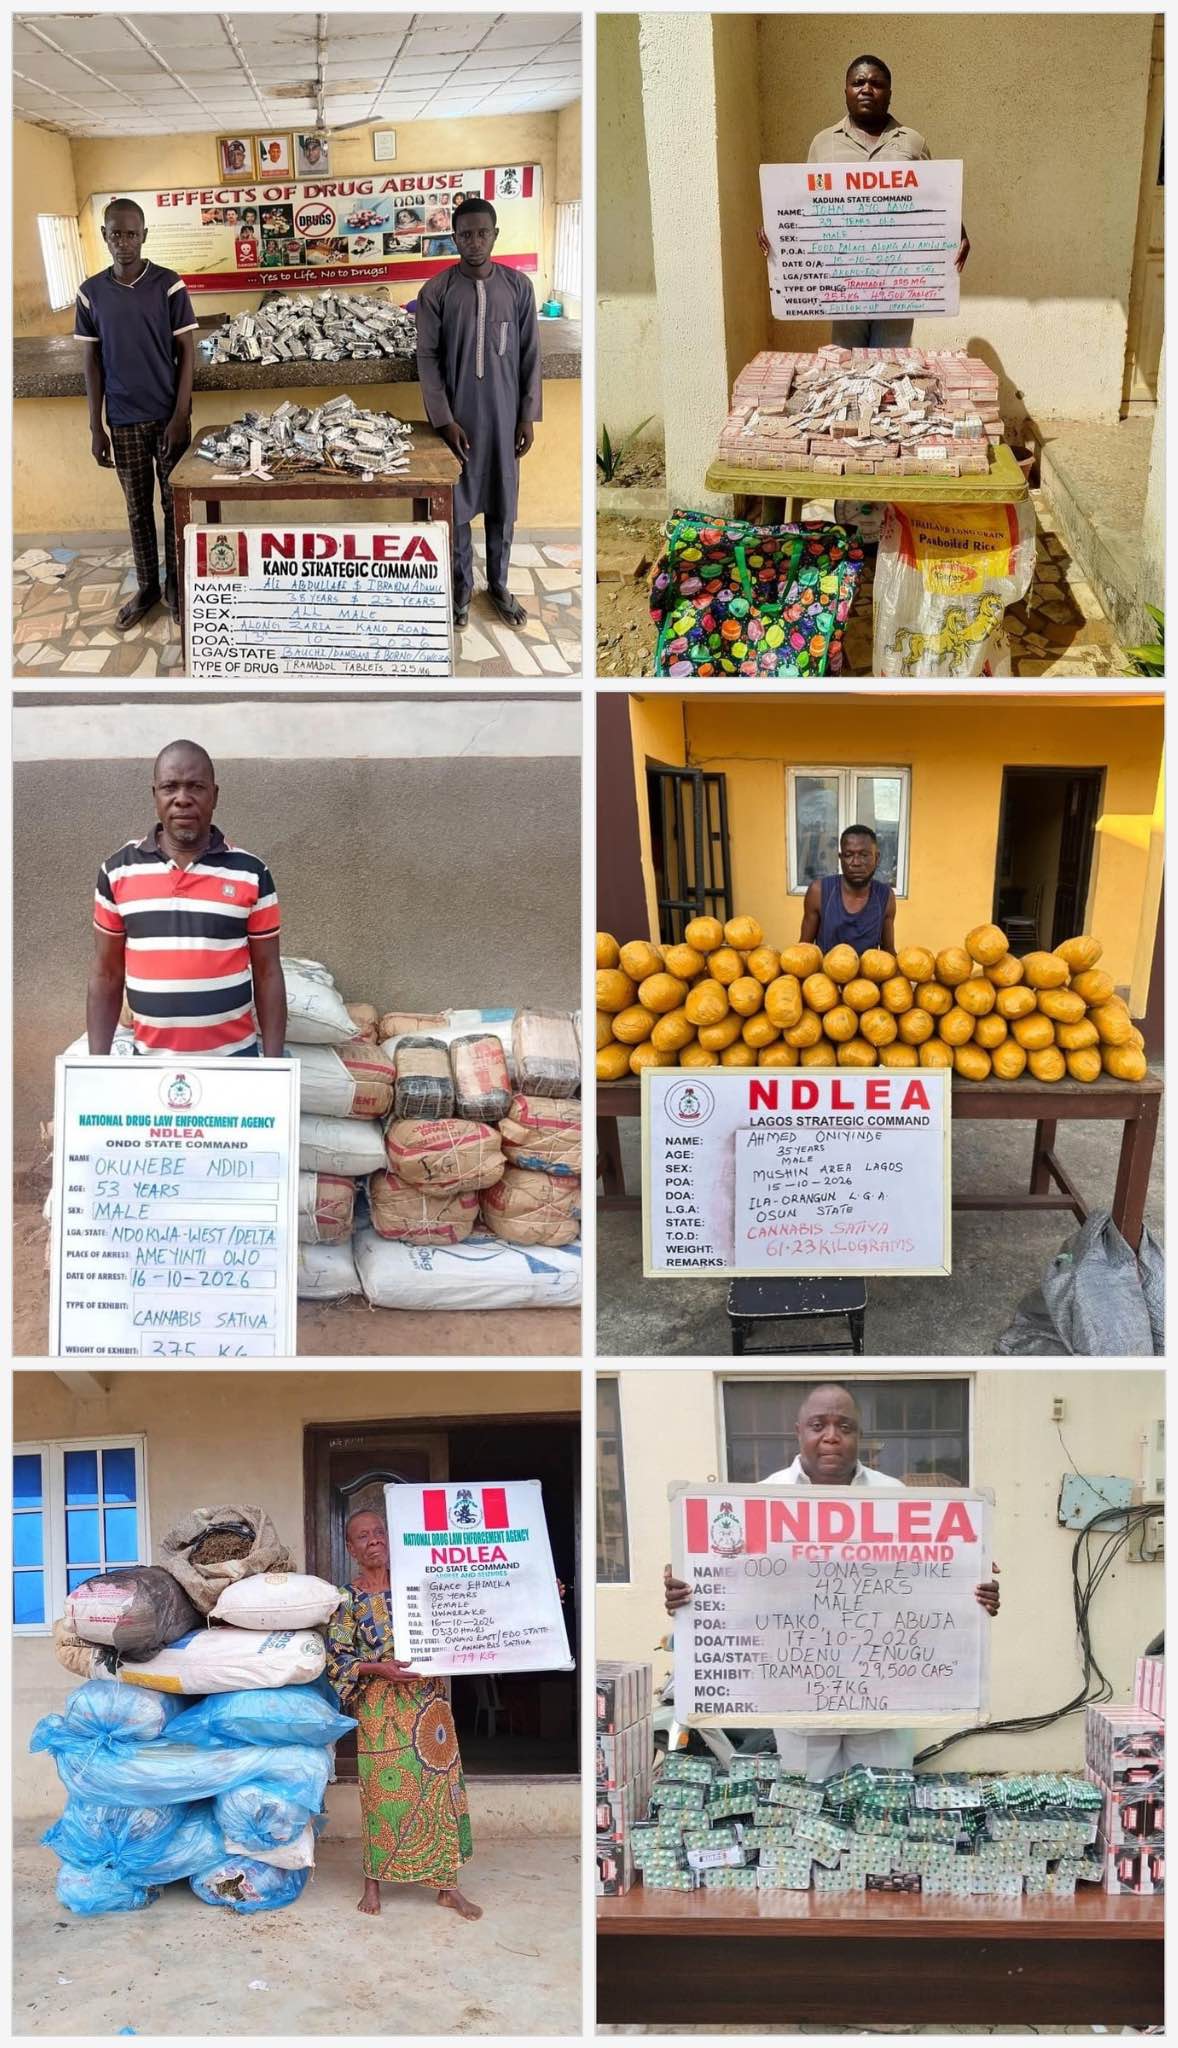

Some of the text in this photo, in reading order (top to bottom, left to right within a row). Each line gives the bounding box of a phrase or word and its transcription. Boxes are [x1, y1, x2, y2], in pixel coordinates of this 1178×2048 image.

[846, 170, 919, 190] NDLEA
[157, 173, 464, 208] EFFECTS OF DRUG ABUSE
[812, 196, 845, 204] KADUNA
[872, 195, 913, 203] COMMAND
[299, 214, 332, 227] DRUGS
[778, 222, 798, 230] AGE:
[779, 235, 798, 243] SEX:
[260, 265, 388, 284] Yes to No to Drugs!
[261, 533, 438, 561] NDLEA
[263, 561, 438, 579] KANO STRATEGIC COMMAND
[194, 583, 247, 592] NAME:
[193, 593, 237, 605] AGE:
[371, 595, 393, 604] 23
[401, 595, 436, 606] YEARS
[193, 622, 233, 633] POA:
[356, 623, 388, 633] KANO
[192, 635, 234, 646] DOA:
[192, 647, 276, 659] LGA/STATE
[192, 661, 222, 671] TYPE
[225, 661, 241, 672] OF
[244, 662, 279, 674] DRUG
[749, 1079, 931, 1110] NDLEA
[79, 1114, 276, 1129] NATIONAL DRUG LAW ENFORCEMENT AGENCY
[750, 1116, 930, 1127] LAGOS STRATEGIC COMMAND
[149, 1128, 205, 1138] NDLEA
[665, 1130, 882, 1148] NAME: AHMED ONIYINDE
[106, 1139, 248, 1149] ONDO STATE COMMAND
[665, 1150, 694, 1159] AGE:
[206, 1158, 254, 1178] NDIDI
[665, 1155, 814, 1173] SEX: MALE
[665, 1162, 904, 1187] POA: MUSHIN AREA LAGOS
[94, 1180, 120, 1198] 53
[133, 1181, 180, 1199] YEARS
[665, 1191, 694, 1200] DOA:
[94, 1202, 151, 1220] MALE
[665, 1205, 699, 1213] L.G.A:
[665, 1204, 853, 1227] STATE: OSUN STATE
[665, 1220, 889, 1240] T.O.D: CANNABIS SATIVA
[66, 1250, 89, 1258] PLACE
[223, 1249, 260, 1265] OWO
[666, 1245, 713, 1254] WEIGHT:
[666, 1258, 727, 1267] REMARKS:
[66, 1272, 84, 1280] DATE
[86, 1272, 95, 1280] OF
[66, 1301, 84, 1309] TYPE
[133, 1309, 268, 1329] CANNABIS SATIVA
[96, 1346, 106, 1354] OF
[770, 1501, 977, 1543] NDLEA
[403, 1528, 530, 1546] NATIONAL DRUG LAW ENFORCEMENT AGENCY
[431, 1545, 508, 1565] NDLEA
[792, 1545, 954, 1562] FCT COMMAND
[425, 1562, 520, 1573] EDO STATE COMMAND
[808, 1561, 878, 1578] JONAS
[893, 1561, 951, 1579] EJIKE
[693, 1578, 913, 1595] AGE: 42 YEARS
[694, 1594, 865, 1612] SEX: MALE
[694, 1619, 726, 1630] POA:
[842, 1611, 883, 1629] FCT
[893, 1611, 955, 1630] ABUJA
[777, 1645, 935, 1663] UDENU ENUGU
[757, 1663, 848, 1680] TRAMADOL
[694, 1686, 730, 1697] MOC:
[694, 1695, 889, 1713] REMARK: DEALING
